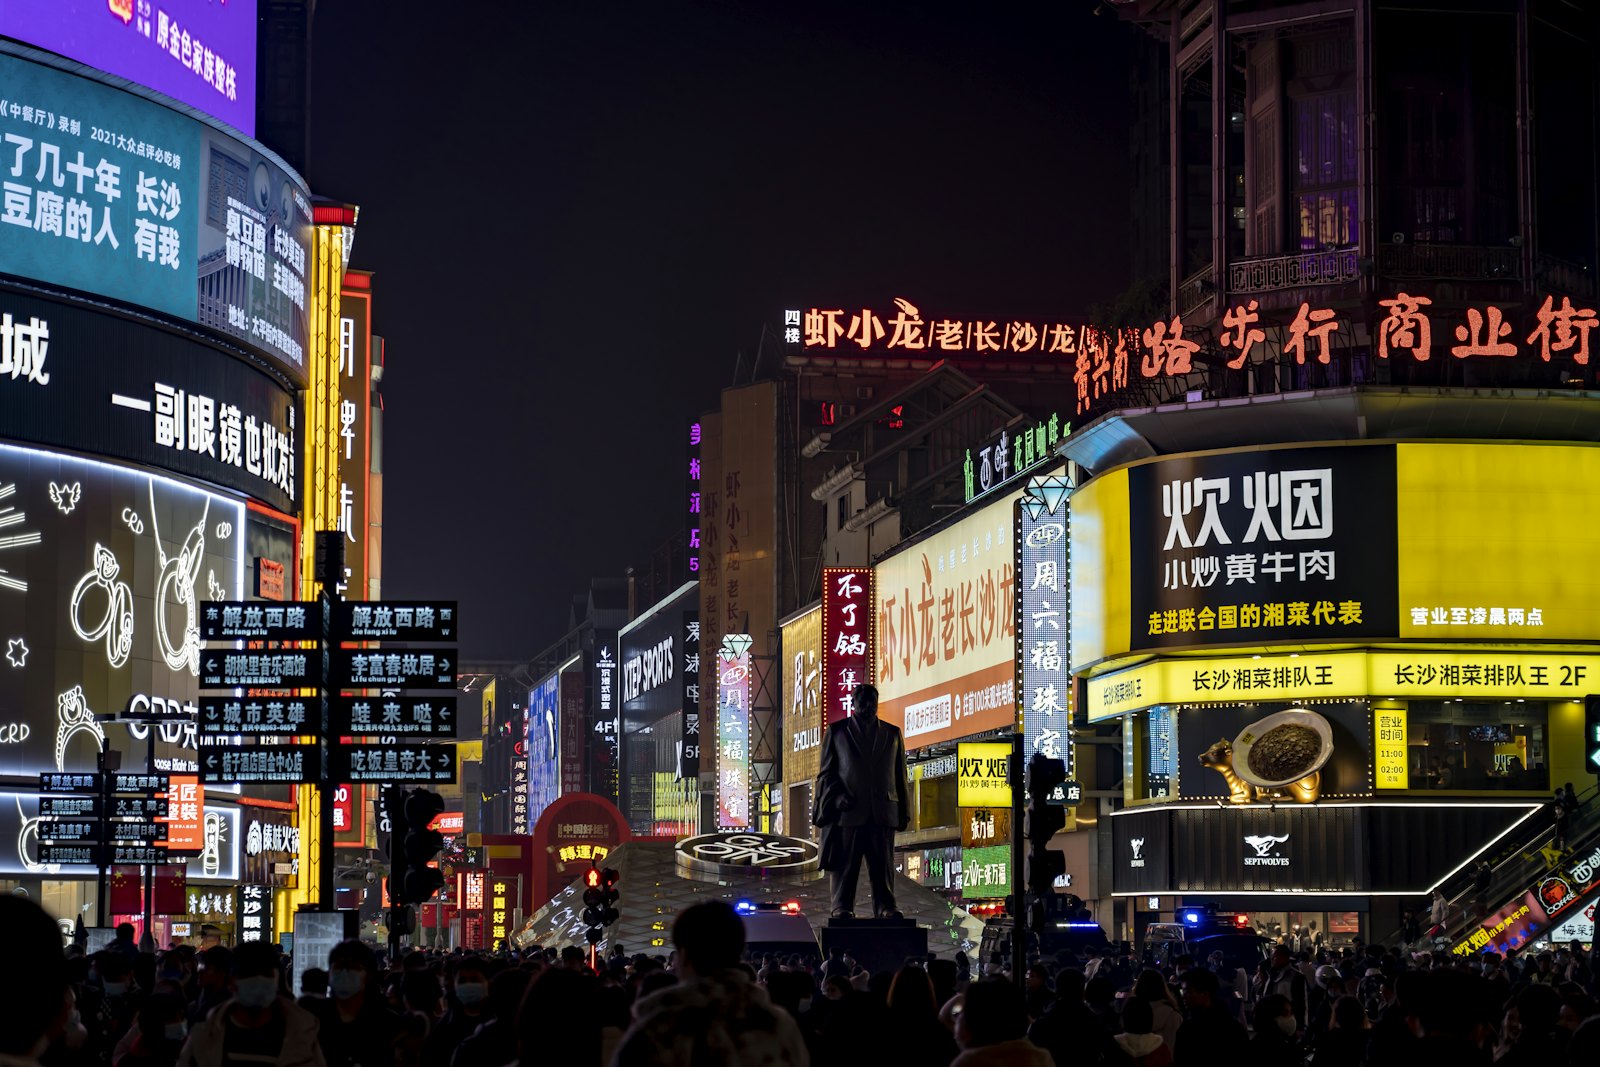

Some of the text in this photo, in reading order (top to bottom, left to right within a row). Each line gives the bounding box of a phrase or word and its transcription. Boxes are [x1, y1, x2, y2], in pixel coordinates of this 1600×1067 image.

[90, 126, 181, 171] 2021大众点评必吃榜
[0, 132, 121, 203] 了几十年
[136, 171, 181, 221] 长沙
[1, 181, 180, 270] 豆腐的人 有我
[226, 208, 266, 254] 臭豆腐
[225, 236, 266, 281] 博物馆
[785, 310, 800, 343] 四楼
[804, 308, 925, 348] 虾小龙
[0, 312, 50, 385] 城
[111, 381, 290, 491] 一副眼镜也批发
[1163, 468, 1334, 551] 炊烟
[1163, 549, 1336, 590] 小炒黄牛肉
[207, 606, 306, 628] 东 解放西路
[352, 606, 452, 628] 解放西路 西
[832, 573, 867, 656] 不了锅
[879, 560, 937, 683] 虾小龙
[1148, 600, 1363, 636] 走进联合国的湘菜代表
[1411, 606, 1544, 627] 营业至凌晨两点
[208, 627, 215, 636] E
[442, 628, 450, 636] W
[225, 655, 306, 676] 胡桃里音乐酒馆
[351, 654, 435, 676] 李富春故居
[623, 636, 673, 703] XTEP SPORTS
[1030, 560, 1064, 760] 周六福珠宝
[1192, 665, 1334, 691] 长沙湘菜排队王
[1394, 664, 1587, 686] 长沙湘菜排队王 2F
[1103, 678, 1142, 706] 长沙湘菜排队王
[223, 702, 305, 724] 城市英雄
[352, 702, 432, 724] 蛙来哒
[1380, 716, 1403, 728] 营业
[595, 720, 612, 734] 4F
[1380, 729, 1403, 741] 时间
[222, 751, 303, 772] 桔子酒店国金中心店
[351, 750, 431, 771] 吃饭皇帝大
[723, 690, 744, 818] 周六福珠宝
[1380, 750, 1403, 758] 11:00
[959, 757, 1007, 778] 炊烟
[1380, 765, 1404, 774] 02:00
[51, 775, 93, 787] 解放西路
[116, 776, 159, 788] 解放西路
[959, 780, 1009, 789] 小炒黄牛肉
[1047, 786, 1080, 800] 总店
[1243, 857, 1290, 866] SEPTWOLVES
[1546, 891, 1577, 915] COFFEE
[1452, 928, 1491, 956] 炊烟
